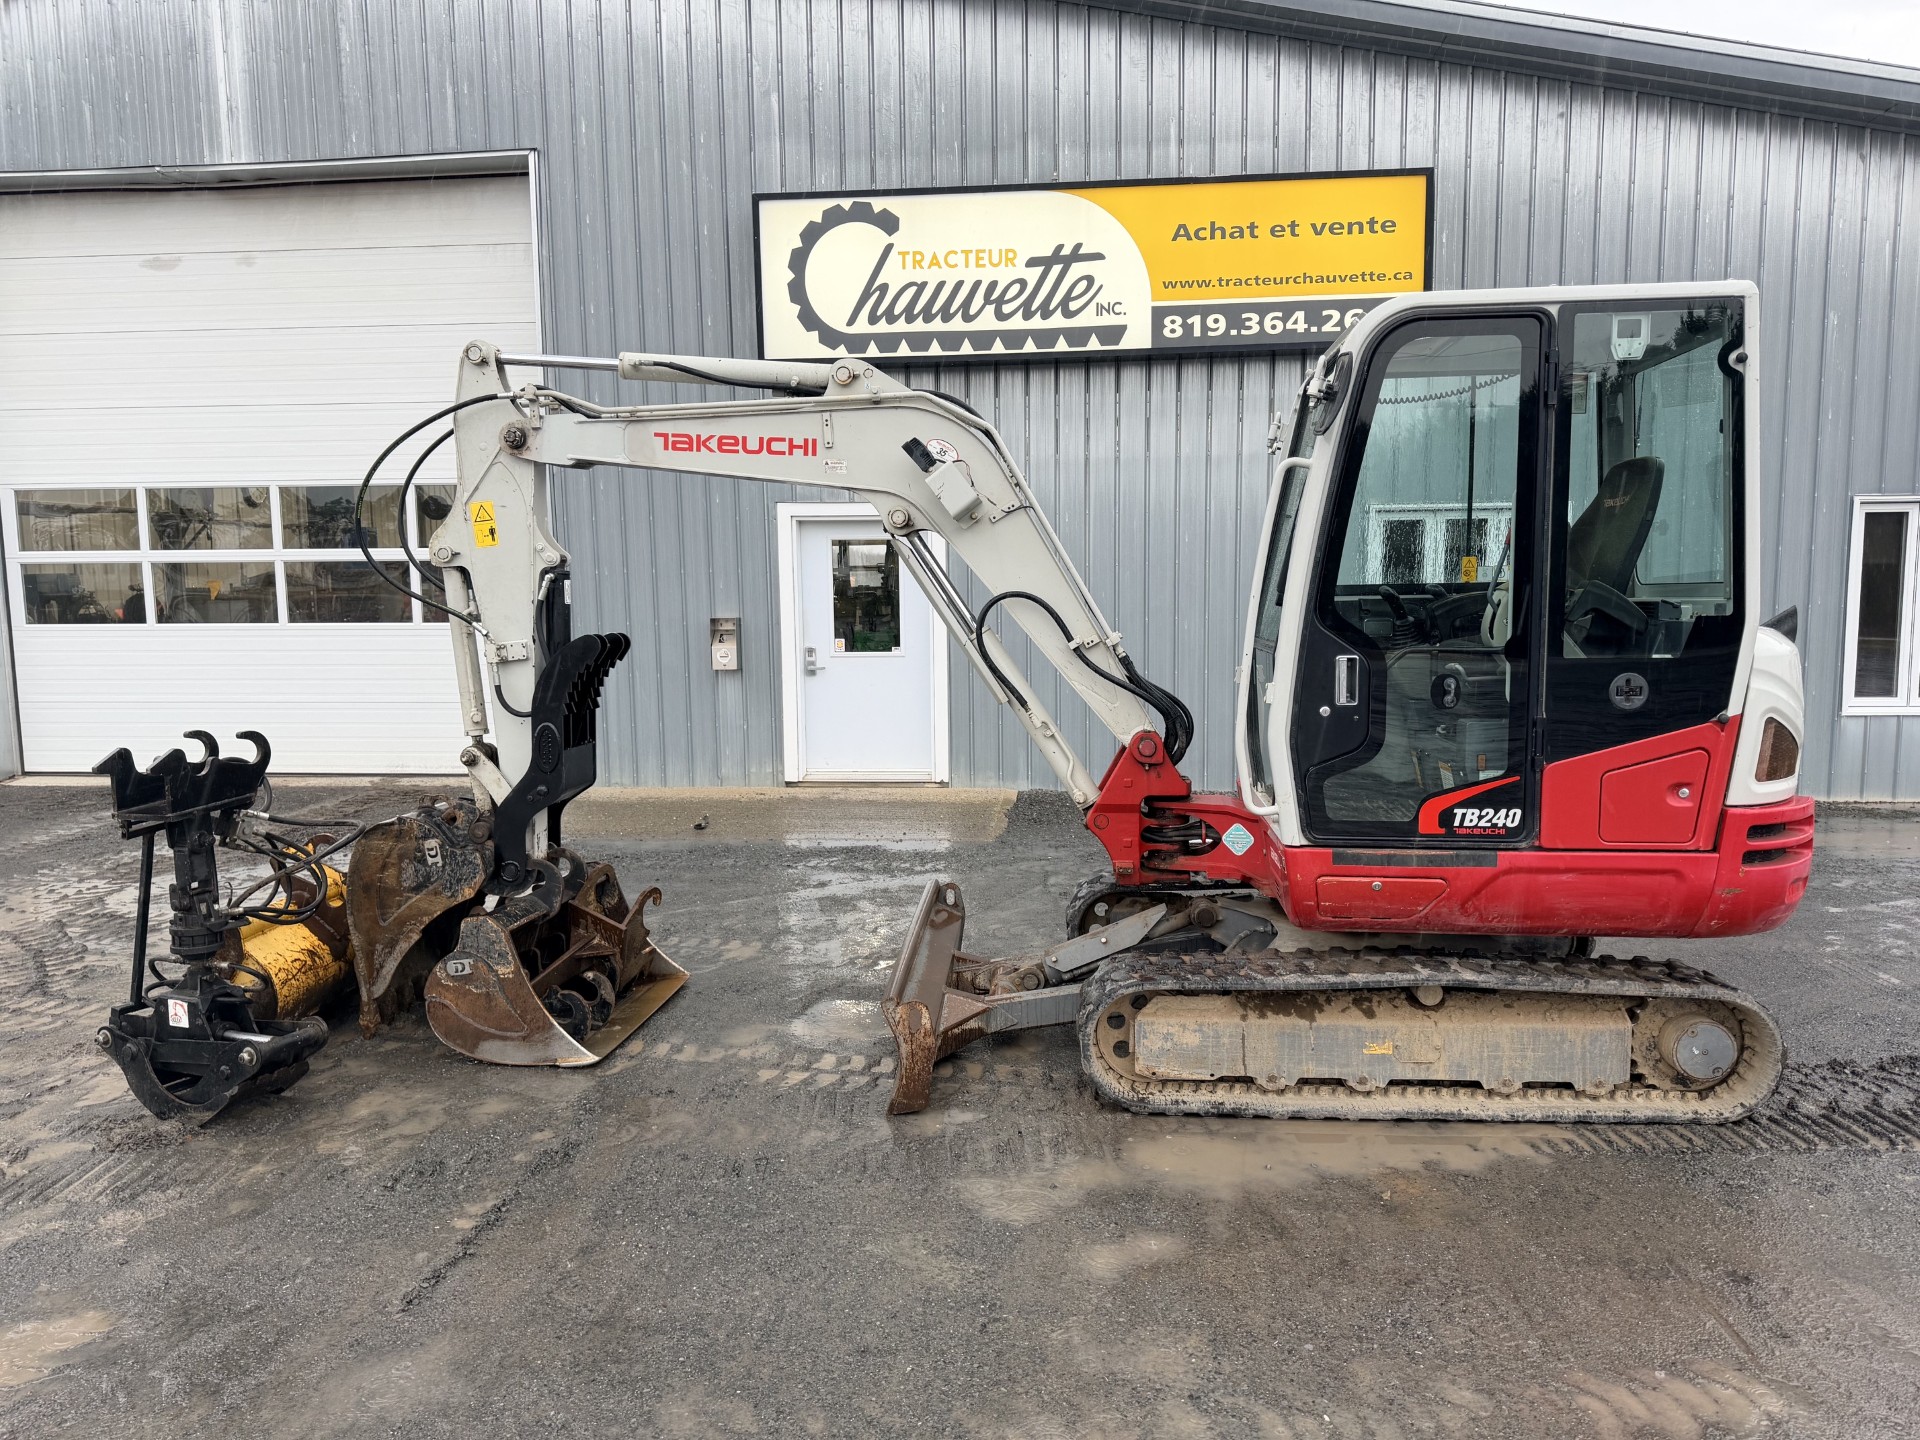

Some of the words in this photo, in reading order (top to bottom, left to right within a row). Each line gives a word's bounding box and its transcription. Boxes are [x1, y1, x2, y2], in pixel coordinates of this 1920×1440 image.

[1171, 221, 1259, 242] Achat
[1269, 220, 1300, 238] et
[1310, 216, 1397, 237] vente
[898, 248, 1018, 270] TRACTEUR
[787, 201, 1112, 354] Chauvette
[1162, 270, 1414, 290] www.tracteurchauvette.ca
[1095, 301, 1127, 317] INC.
[653, 432, 818, 457] TAKEUCHI
[1453, 808, 1522, 827] TB240
